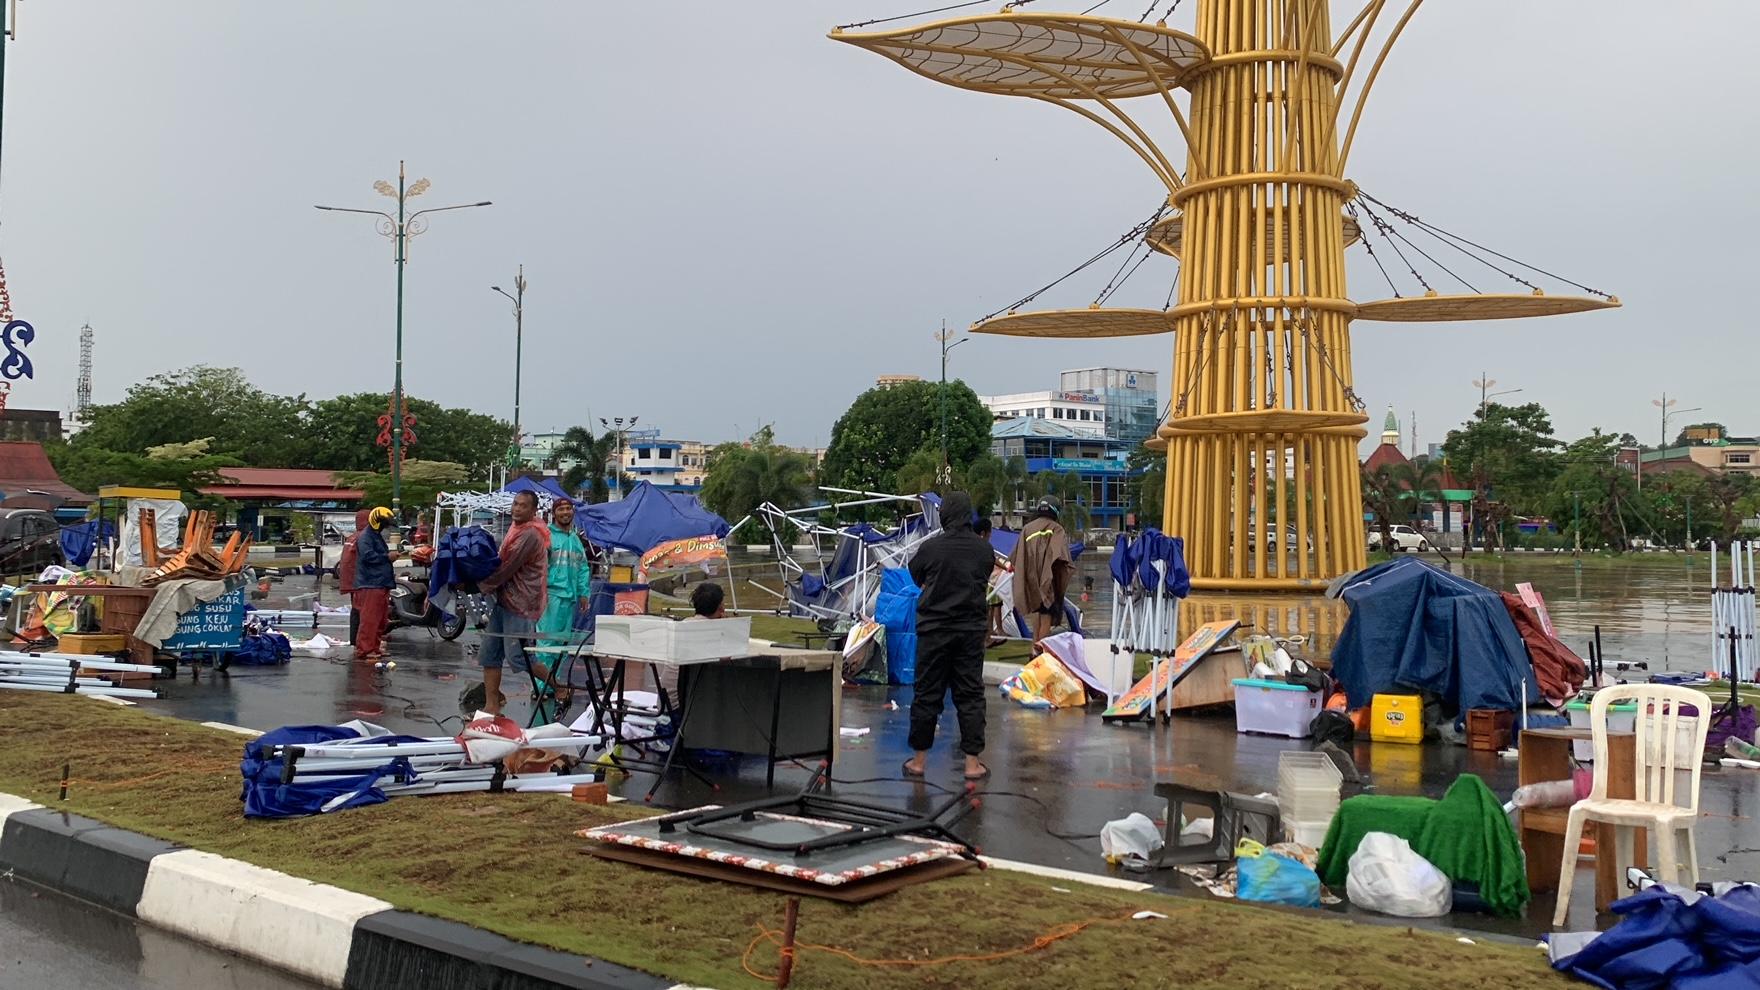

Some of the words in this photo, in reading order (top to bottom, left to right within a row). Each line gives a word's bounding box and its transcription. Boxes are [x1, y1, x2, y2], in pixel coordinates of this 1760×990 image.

[1064, 393, 1100, 402] PaninBank
[205, 604, 232, 613] SUSU
[205, 614, 229, 624] KEJU
[202, 623, 233, 633] COKLAT
